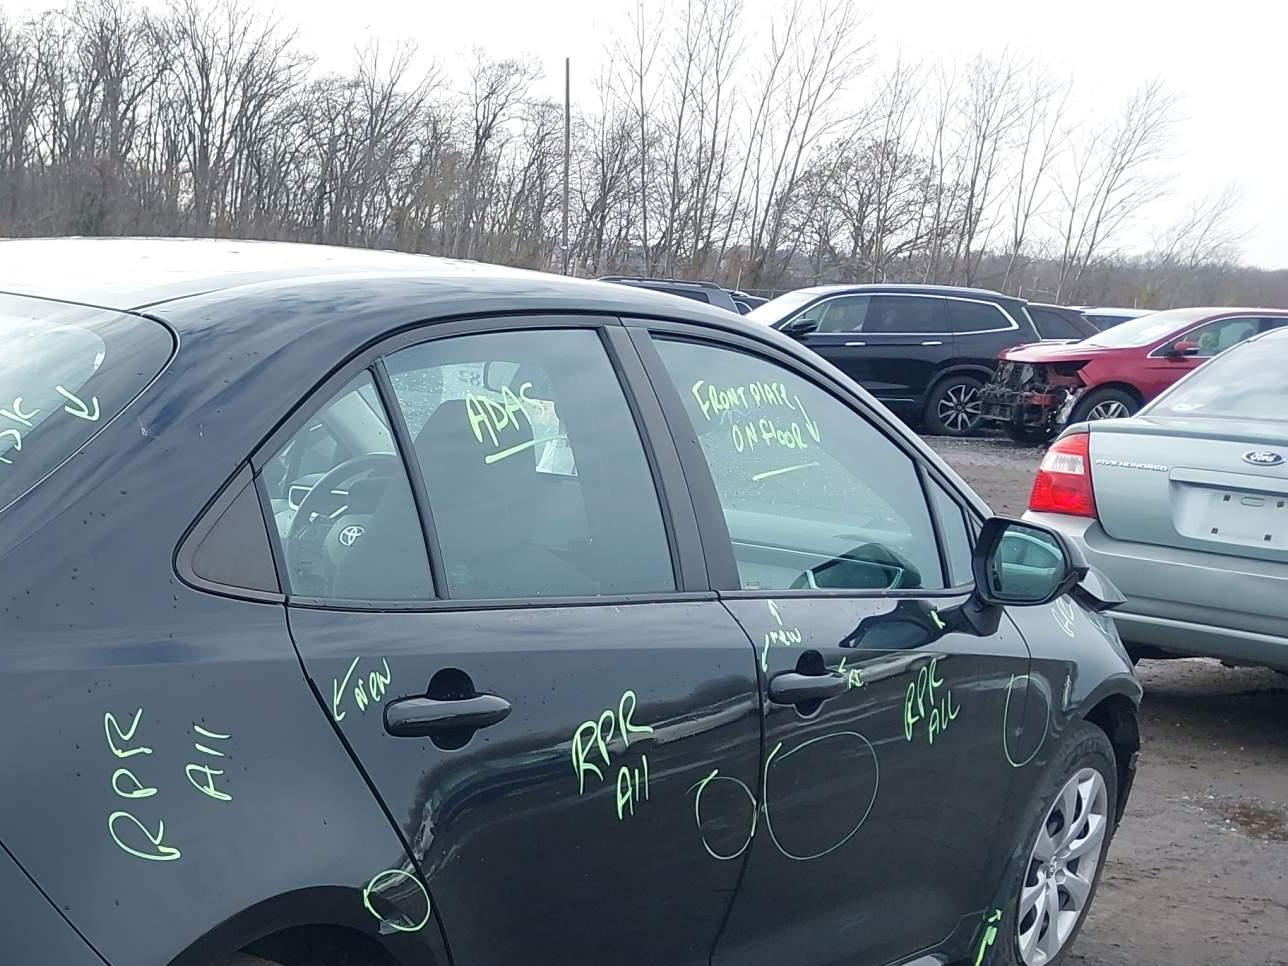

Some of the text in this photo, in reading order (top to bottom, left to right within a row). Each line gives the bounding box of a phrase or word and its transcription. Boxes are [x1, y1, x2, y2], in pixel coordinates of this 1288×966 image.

[692, 380, 745, 421] FRONT
[732, 422, 759, 453] ON
[572, 690, 654, 796] RPR
[104, 707, 182, 861] RPR
